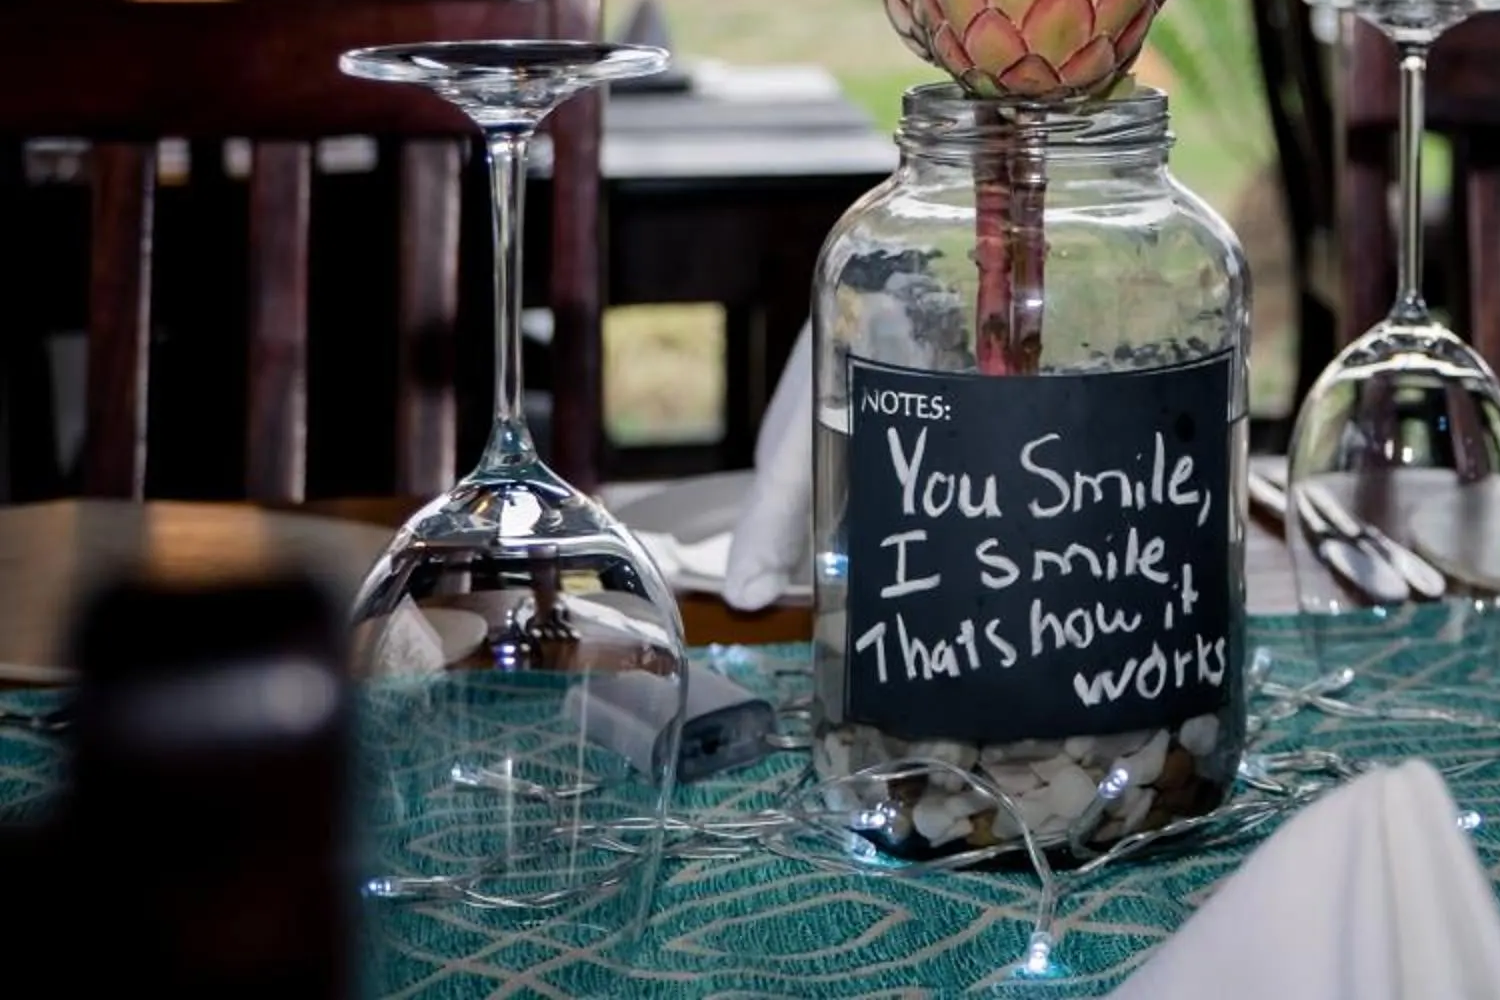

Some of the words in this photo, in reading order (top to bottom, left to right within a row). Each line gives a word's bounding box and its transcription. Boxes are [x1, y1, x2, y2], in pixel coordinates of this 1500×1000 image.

[861, 387, 951, 420] NOTES:
[887, 426, 1002, 518] You
[1020, 431, 1211, 527] Smile,
[880, 529, 940, 599] I
[855, 613, 1017, 683] Thats
[1030, 599, 1141, 657] how
[1164, 563, 1199, 629] it
[1073, 633, 1226, 707] works
